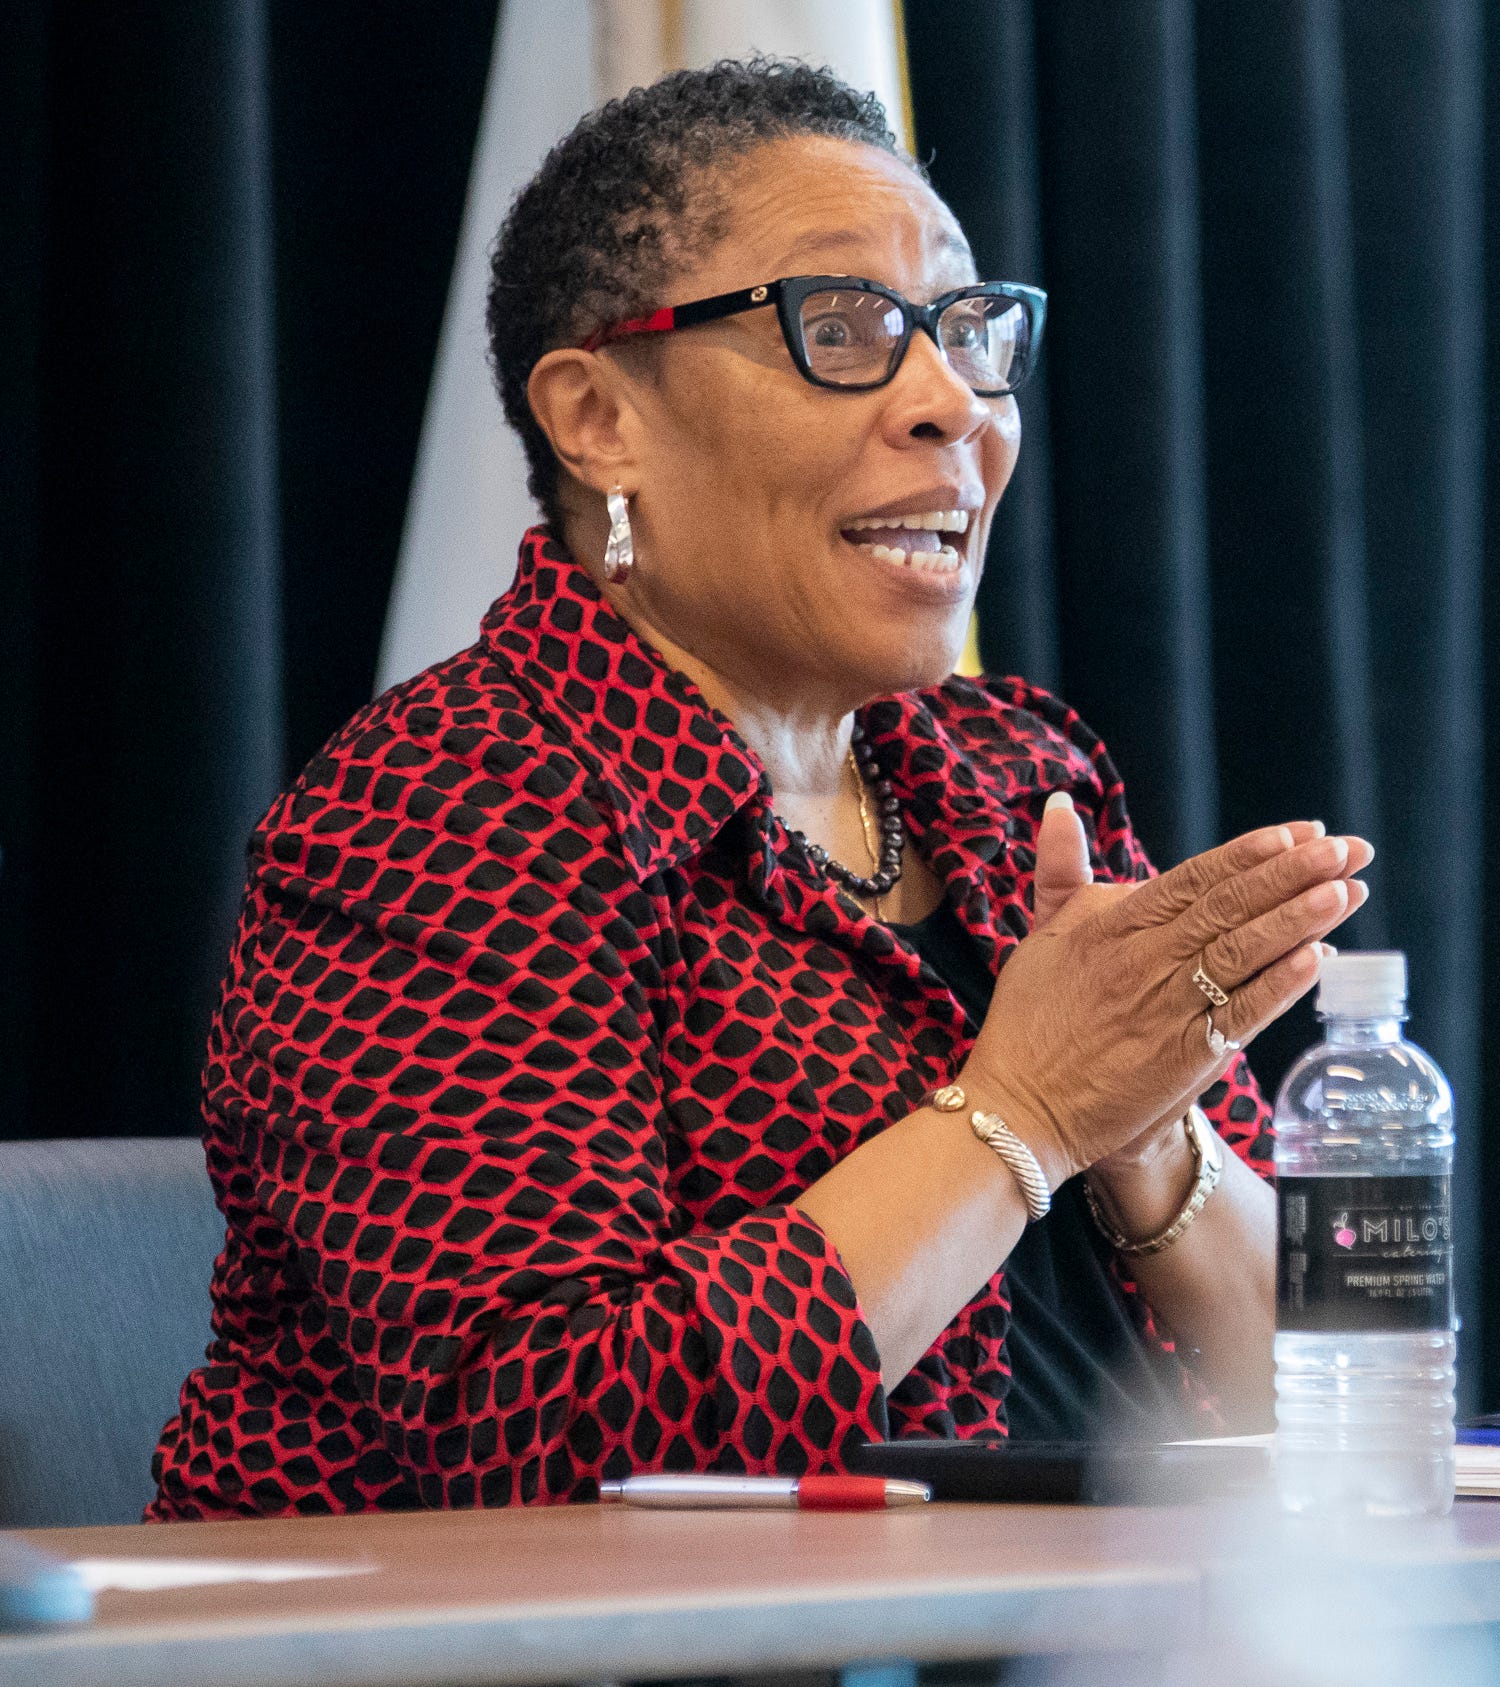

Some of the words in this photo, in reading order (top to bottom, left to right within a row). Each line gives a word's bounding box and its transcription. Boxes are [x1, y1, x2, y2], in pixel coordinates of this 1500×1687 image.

[1363, 1217, 1451, 1242] MILO'S
[1346, 1275, 1391, 1287] PREMIUM
[1393, 1274, 1424, 1286] SPRING
